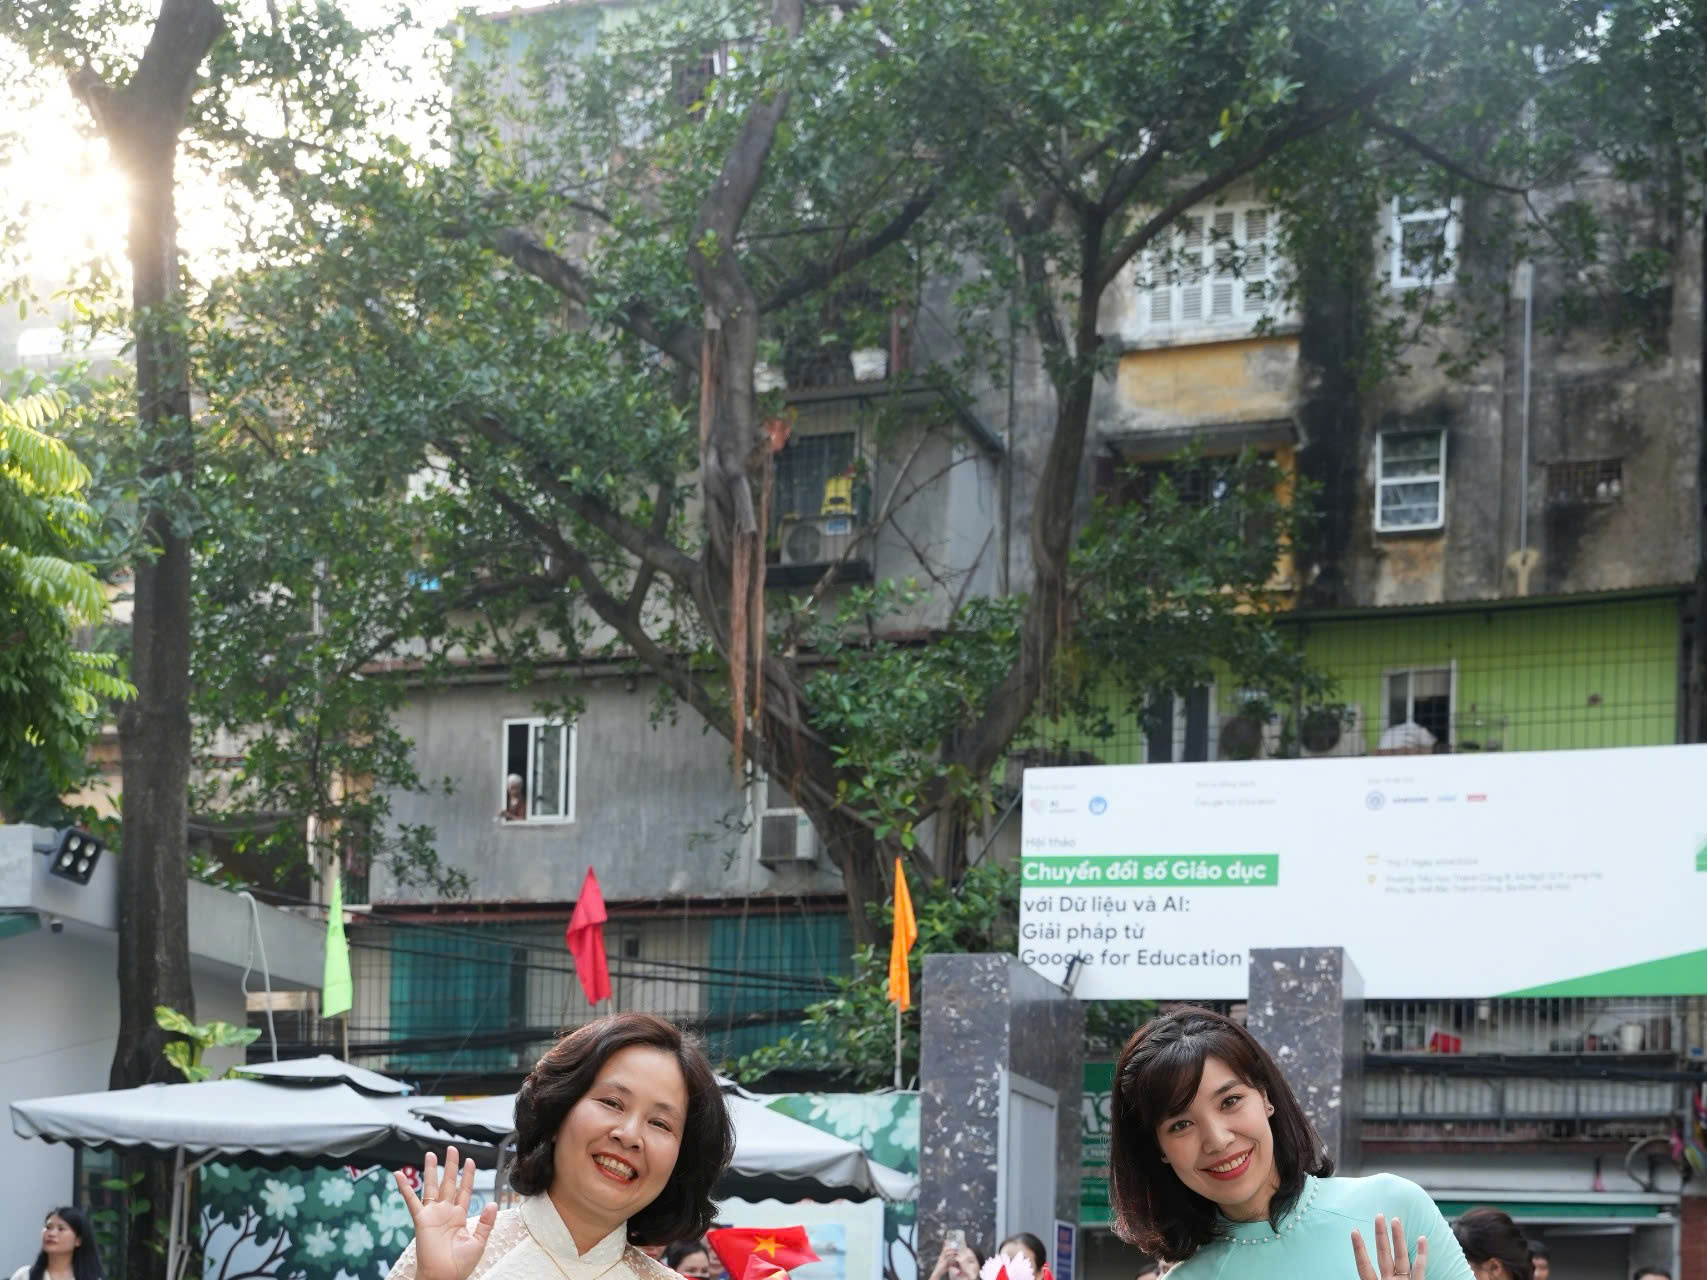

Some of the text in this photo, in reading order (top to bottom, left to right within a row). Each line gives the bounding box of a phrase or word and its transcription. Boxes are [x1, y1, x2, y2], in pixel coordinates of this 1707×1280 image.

[1023, 859, 1267, 885] Chuyển đổi số Giáo dục
[1024, 895, 1190, 917] với Dữ liệu và AI:
[1022, 922, 1145, 943] Giải pháp từ
[1101, 949, 1131, 965] for
[1137, 949, 1242, 966] Education
